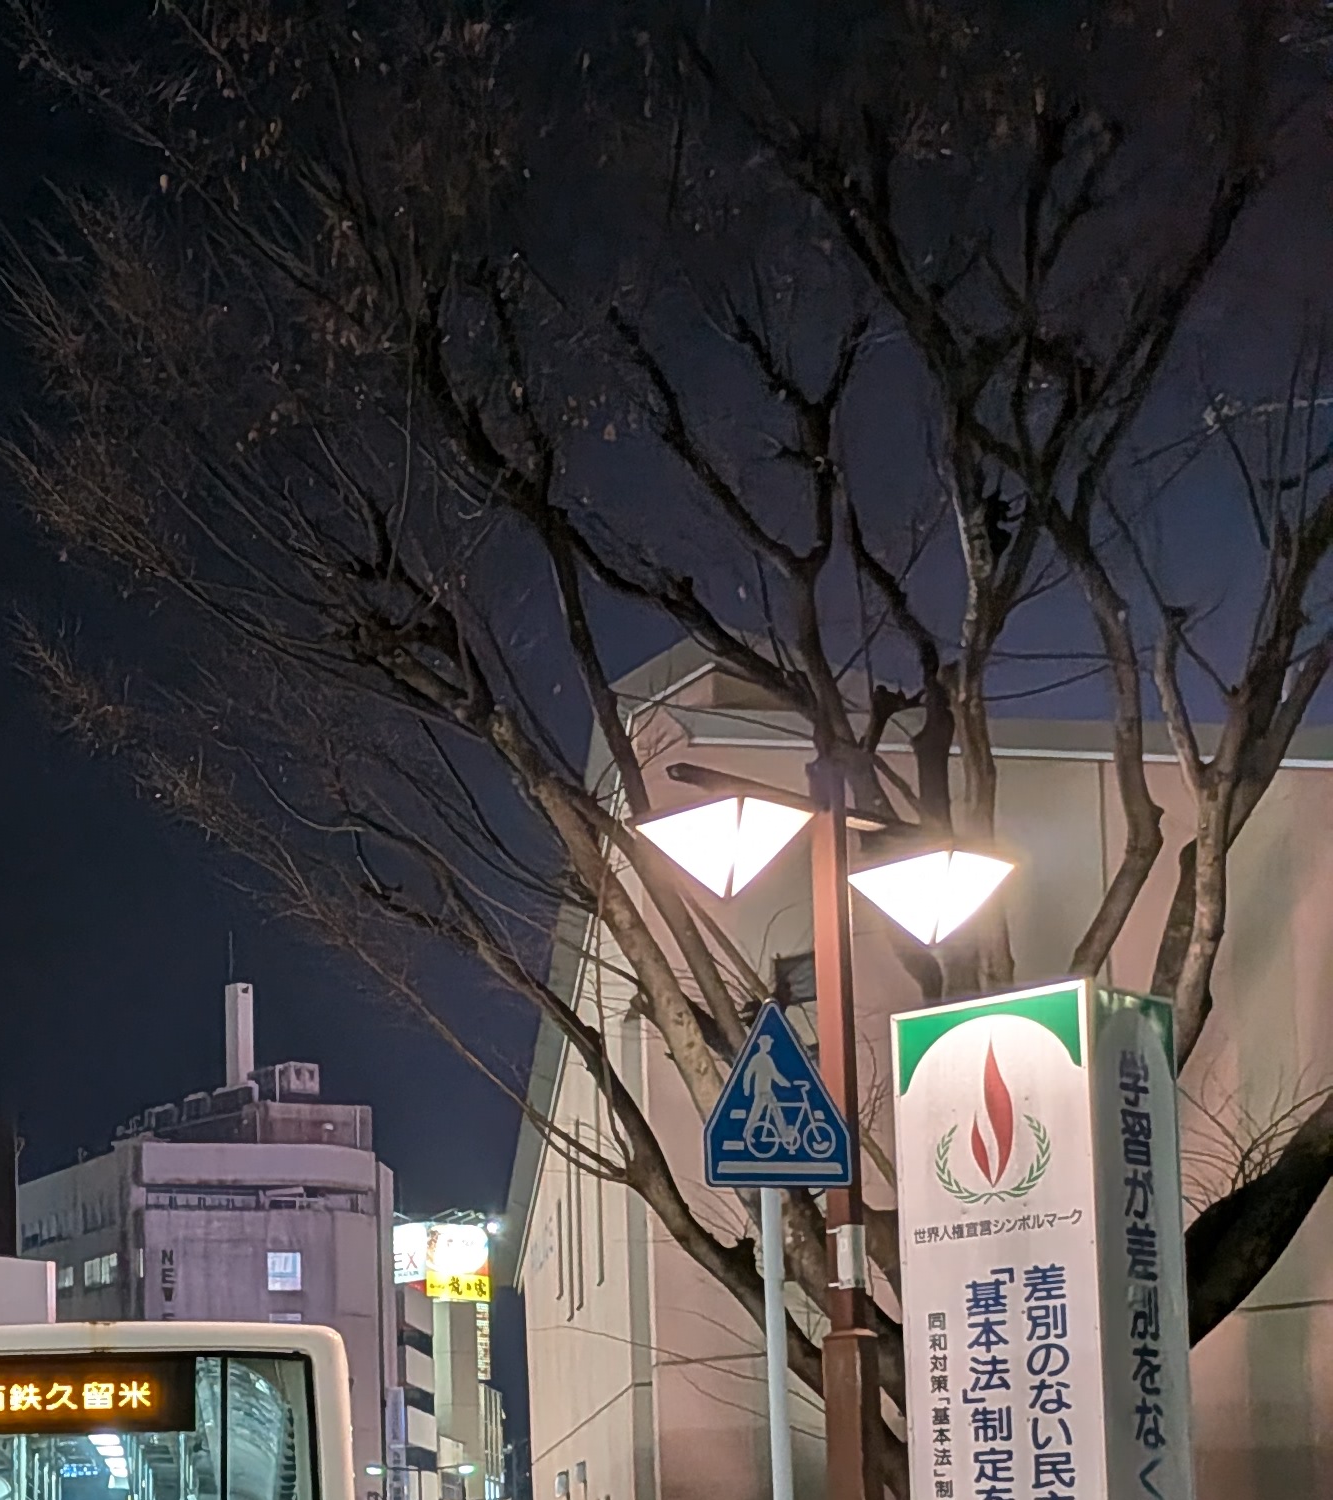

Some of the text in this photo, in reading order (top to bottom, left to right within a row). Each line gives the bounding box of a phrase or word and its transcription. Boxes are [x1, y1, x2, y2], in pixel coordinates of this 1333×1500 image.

[913, 1208, 1083, 1245] 世界人権宣言シンボルマーク
